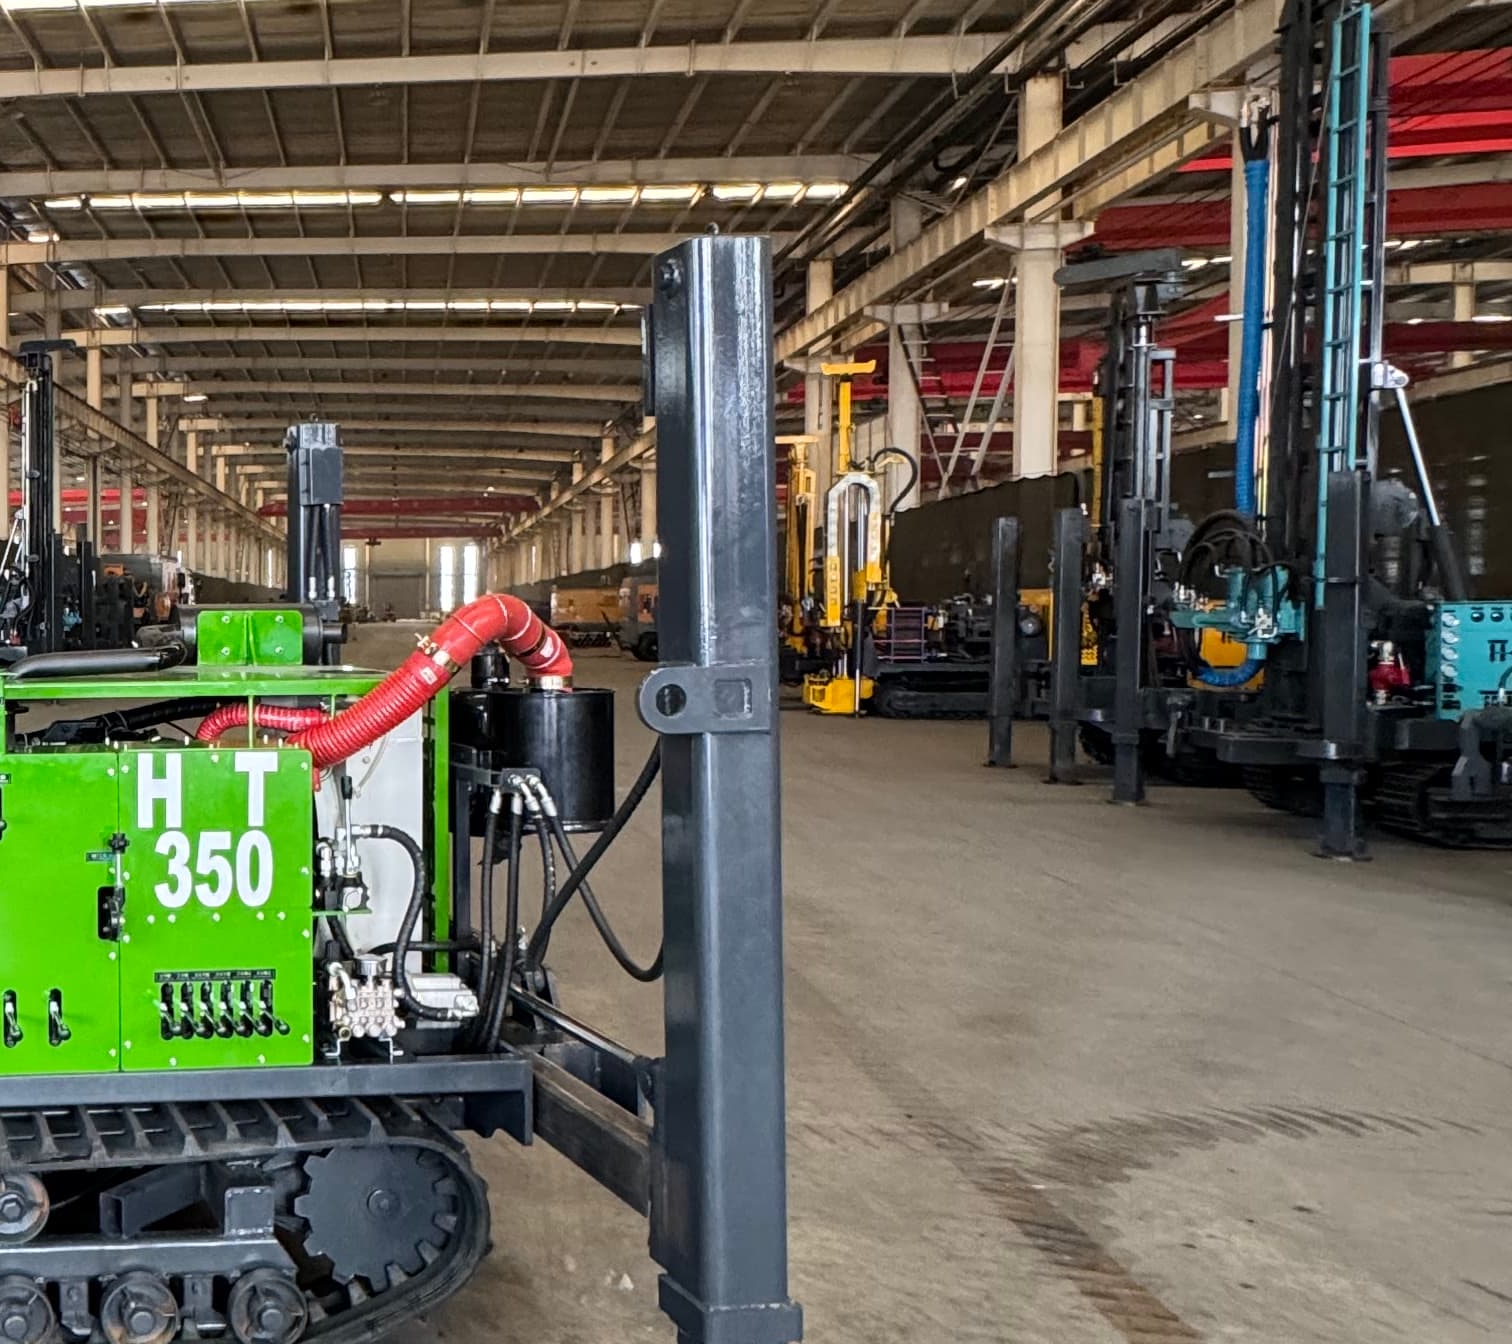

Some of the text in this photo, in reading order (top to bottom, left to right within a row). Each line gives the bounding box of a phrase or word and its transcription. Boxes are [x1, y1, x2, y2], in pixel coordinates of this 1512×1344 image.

[138, 752, 279, 828] H T
[154, 830, 273, 908] 350
